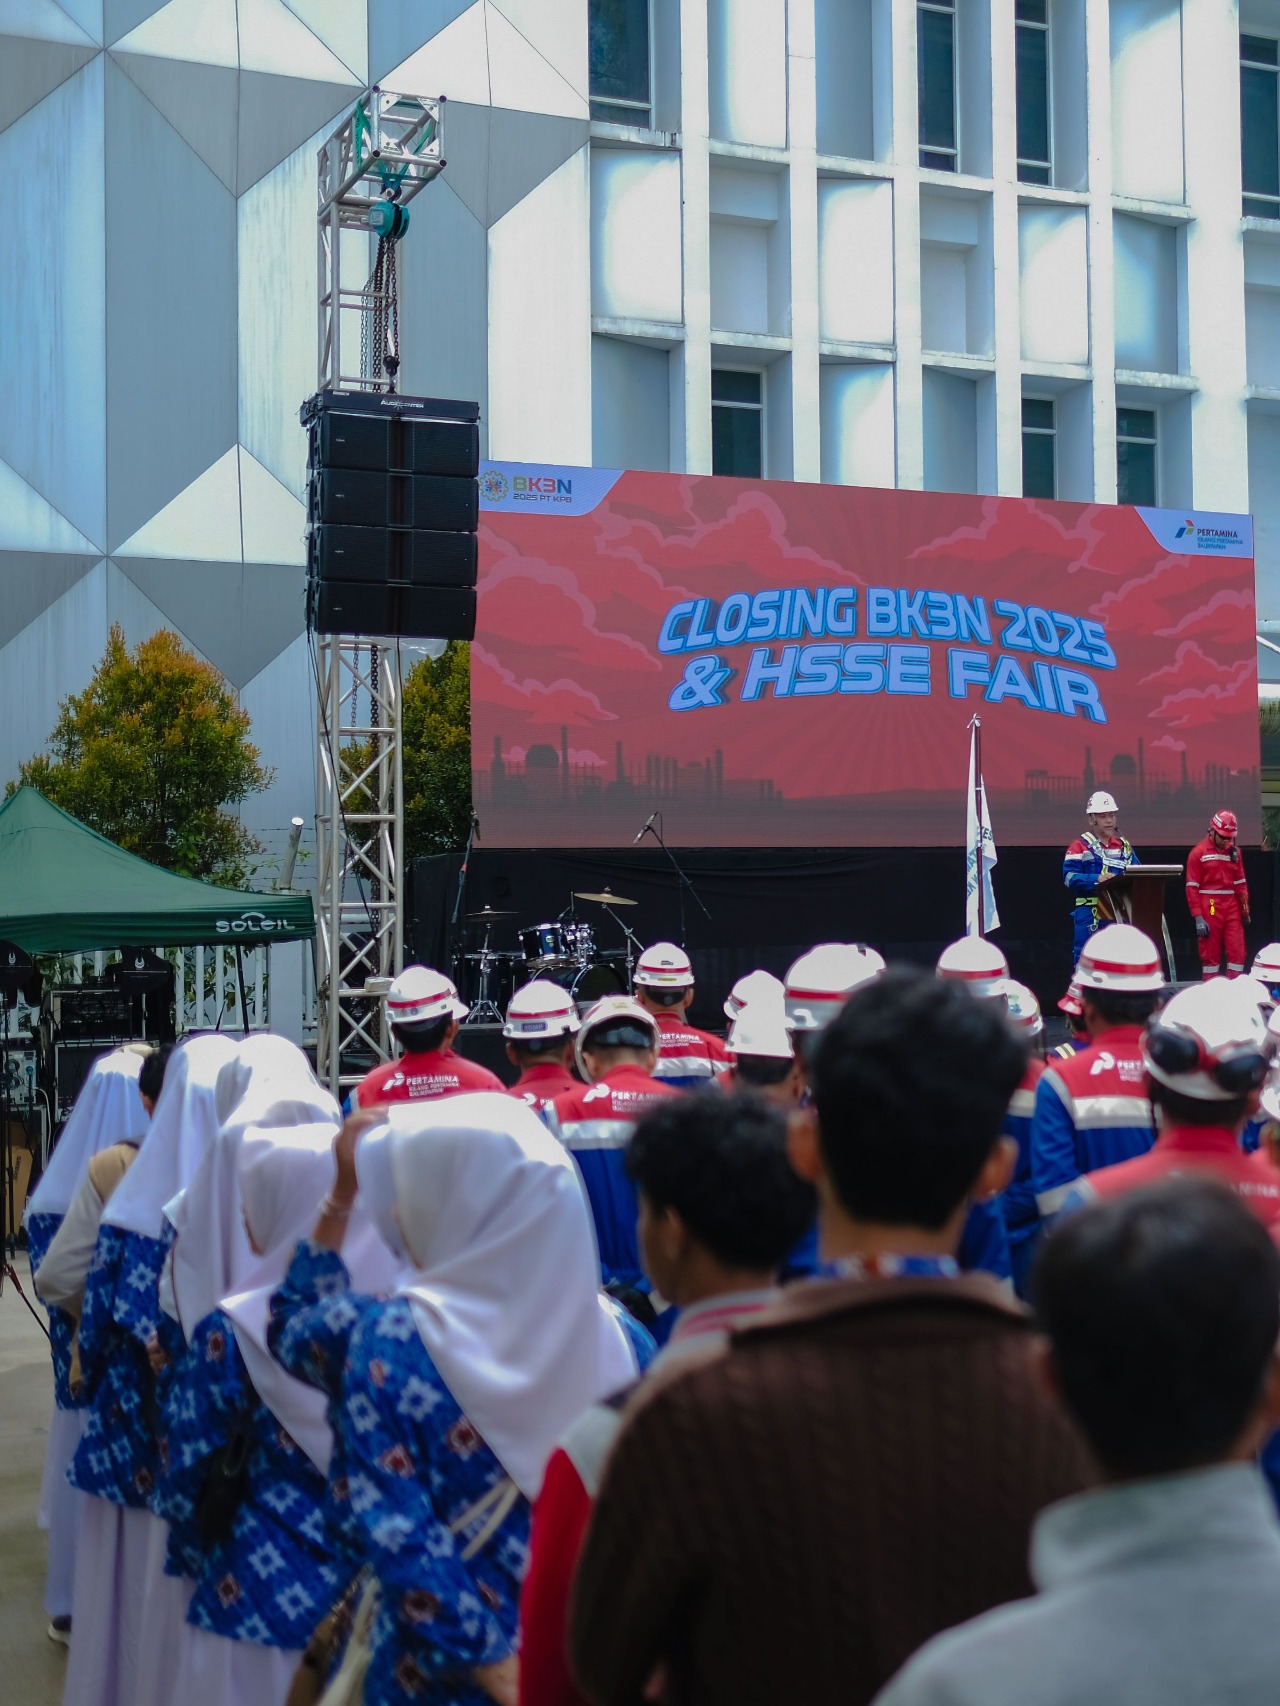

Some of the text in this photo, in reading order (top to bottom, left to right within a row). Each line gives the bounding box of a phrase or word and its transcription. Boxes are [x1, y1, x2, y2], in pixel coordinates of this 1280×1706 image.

[513, 493, 538, 501] 2025
[1197, 528, 1238, 538] PERTAMINA
[658, 587, 857, 655] CLOSING
[994, 598, 1117, 669] 2025
[668, 643, 1108, 724] & HSSE FAIR
[660, 1033, 700, 1041] ERTAMINA
[406, 1075, 459, 1086] PERTAMINA
